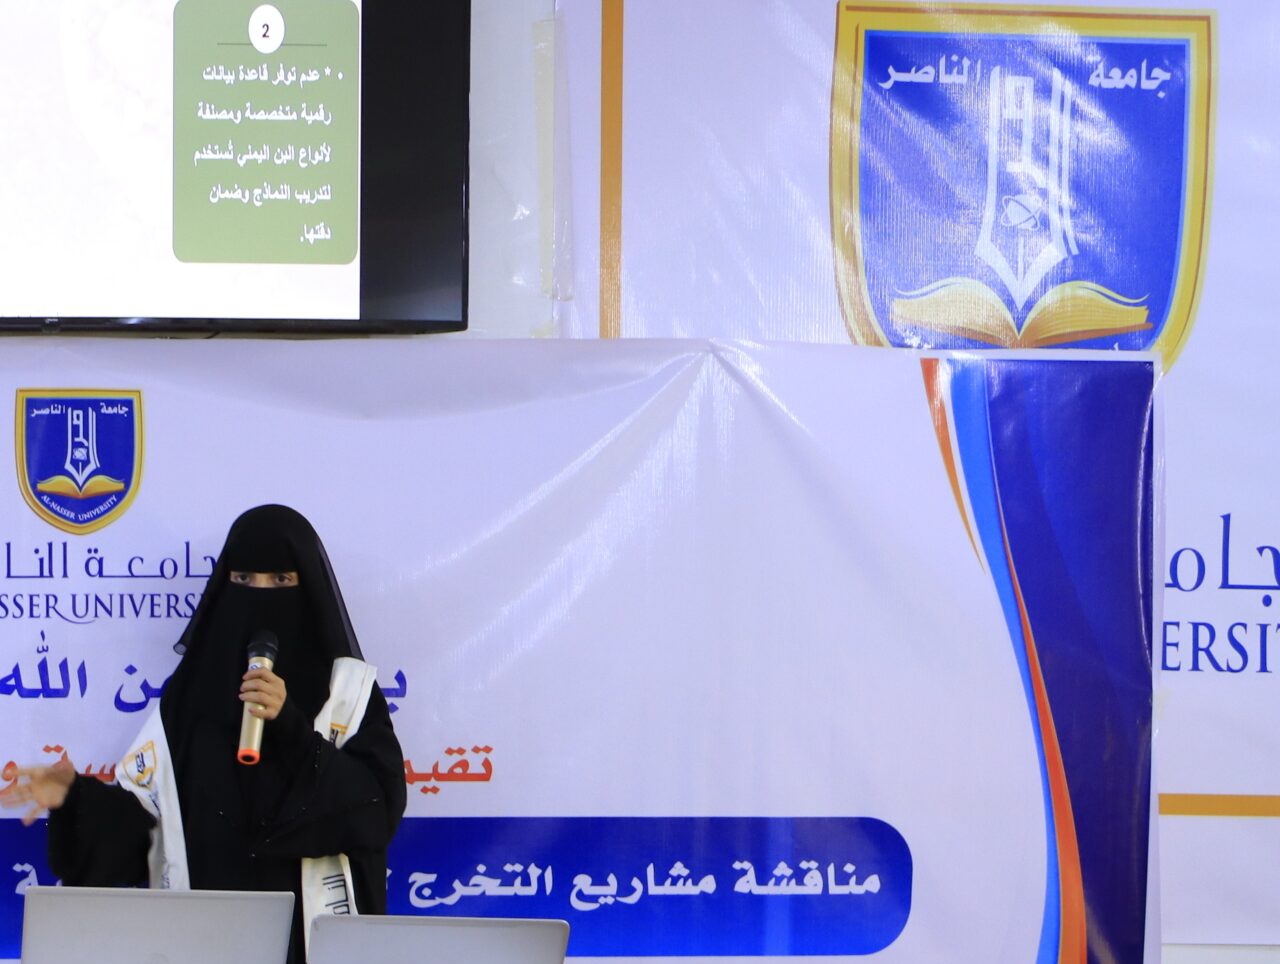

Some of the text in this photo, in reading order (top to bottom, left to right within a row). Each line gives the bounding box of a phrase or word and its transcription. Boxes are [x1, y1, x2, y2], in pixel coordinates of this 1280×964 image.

[261, 22, 270, 39] 2
[202, 63, 321, 89] عدم توفر قاعدة بيانات
[878, 53, 1171, 98] جامعة الناصر
[197, 101, 332, 125] رقمية متخصصة ومصنفة
[236, 143, 270, 167] اليمني
[273, 143, 295, 165] البن
[298, 142, 332, 168] لأنواع
[209, 181, 332, 207] لتدريب النماذج وضمان
[30, 401, 129, 418] جامعة الناصر
[40, 494, 118, 521] AL-NASSER UNIVERSITY
[1161, 621, 1280, 674] ERSI
[407, 862, 554, 909] التخرج
[569, 859, 717, 912] مشاريع
[732, 859, 881, 896] مناقشة
